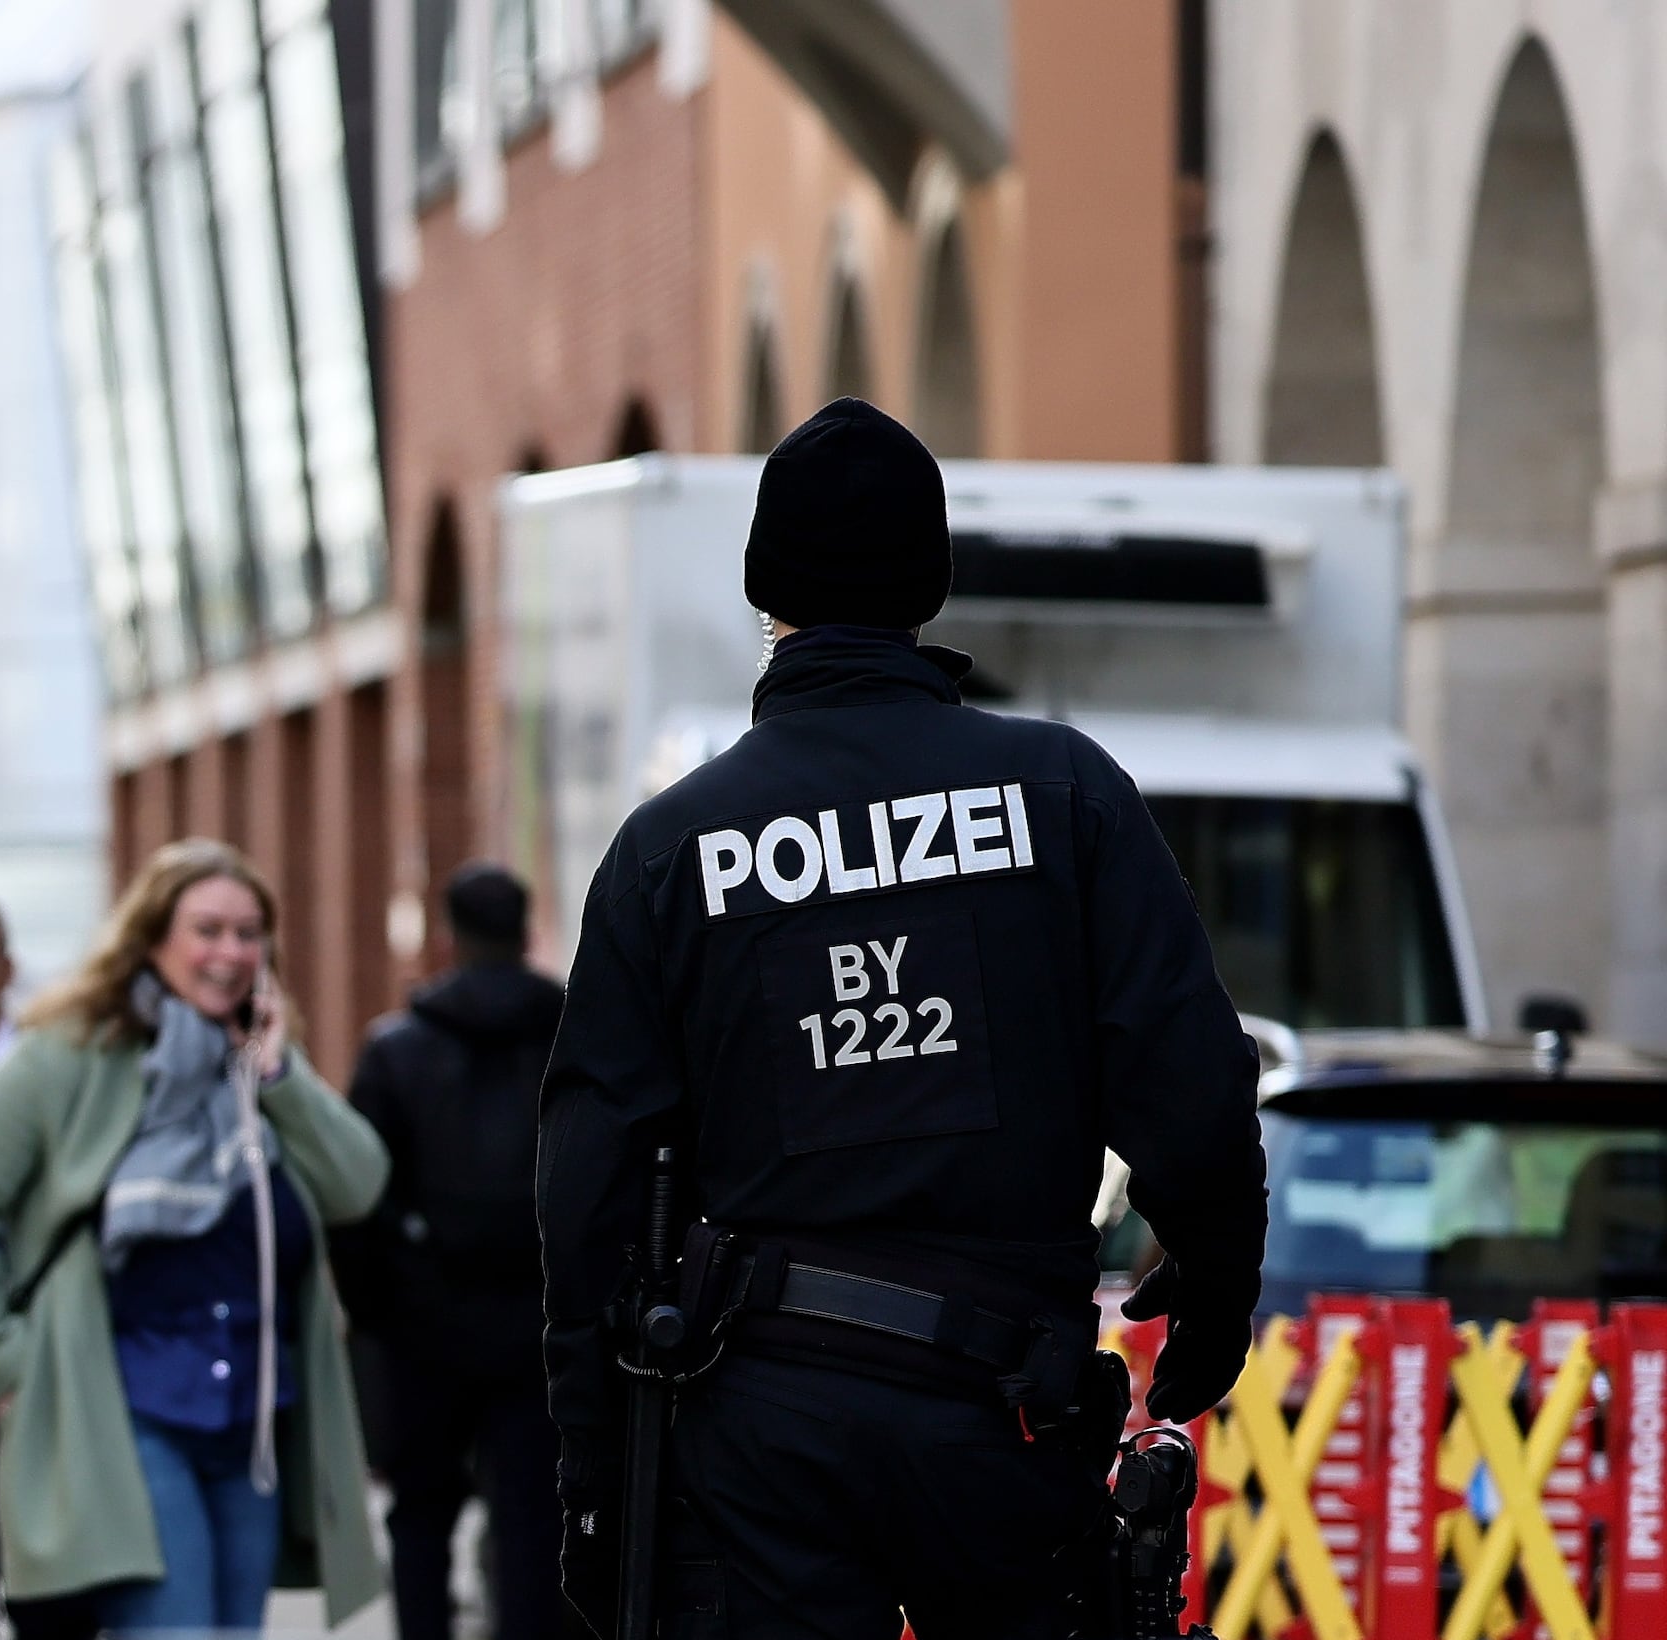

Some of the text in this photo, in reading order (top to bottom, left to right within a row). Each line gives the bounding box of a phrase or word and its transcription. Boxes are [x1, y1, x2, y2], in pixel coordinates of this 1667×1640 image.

[697, 781, 1035, 917] POLIZEI
[798, 996, 959, 1070] 1222
[828, 935, 908, 1003] BY
[1386, 1345, 1427, 1554] PITAGONE
[1626, 1351, 1666, 1560] PITAGONE
